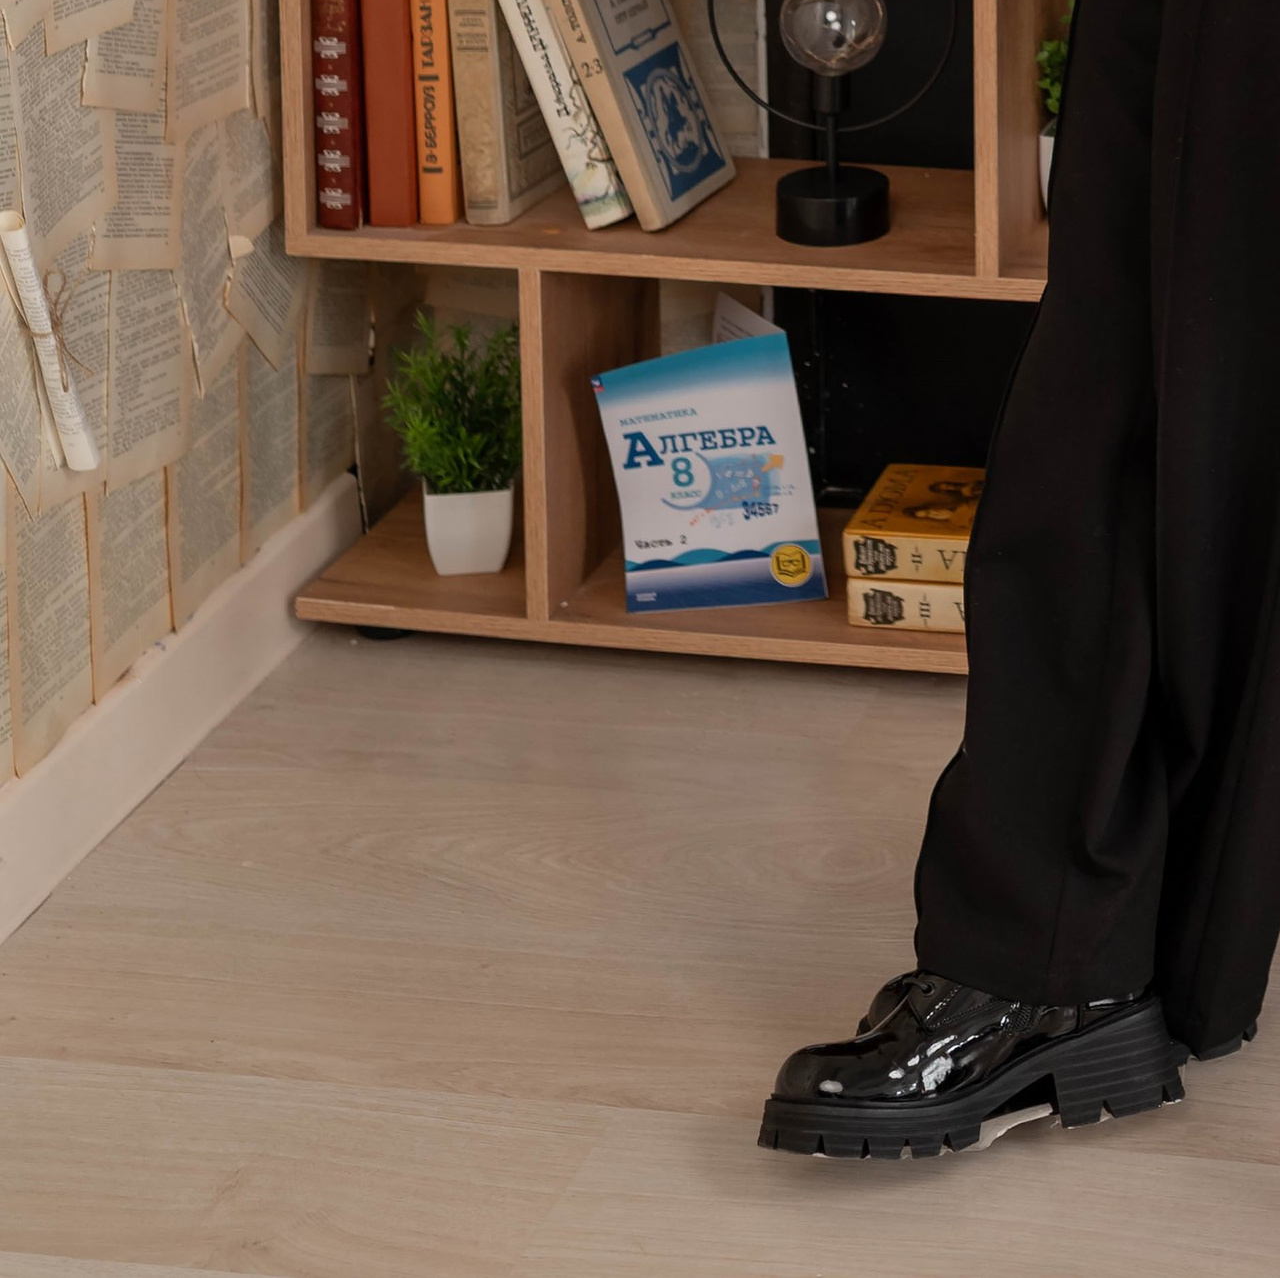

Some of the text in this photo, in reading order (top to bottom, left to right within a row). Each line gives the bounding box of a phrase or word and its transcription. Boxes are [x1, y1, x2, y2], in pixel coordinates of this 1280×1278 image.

[619, 407, 698, 428] МАТЕМАТИКА
[622, 425, 777, 470] АЛГЕБРА
[671, 456, 694, 488] 8
[635, 535, 688, 550] Часть 2
